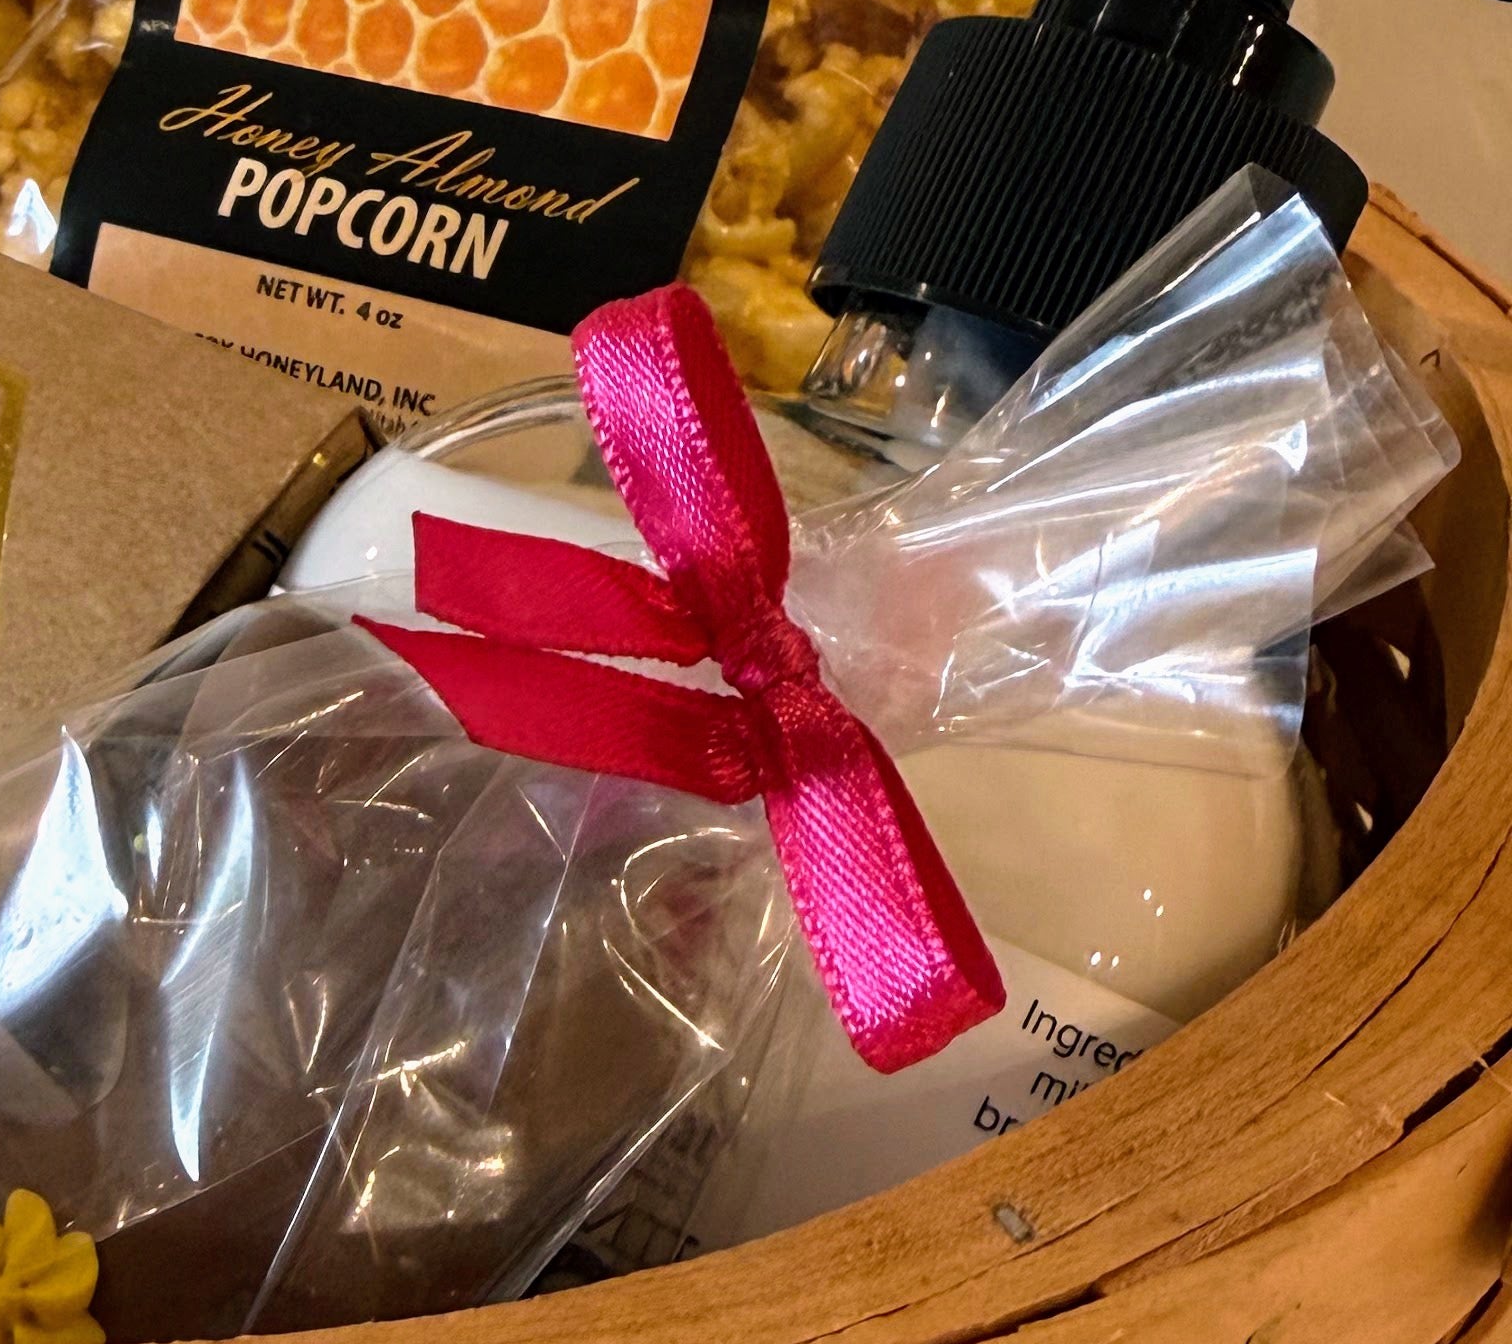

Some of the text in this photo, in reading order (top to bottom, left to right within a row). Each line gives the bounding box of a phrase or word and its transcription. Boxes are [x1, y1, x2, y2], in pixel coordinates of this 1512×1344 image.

[158, 83, 641, 225] Honey Almond
[216, 156, 510, 280] POPCORN
[256, 274, 404, 329] NET WT. 4 oz
